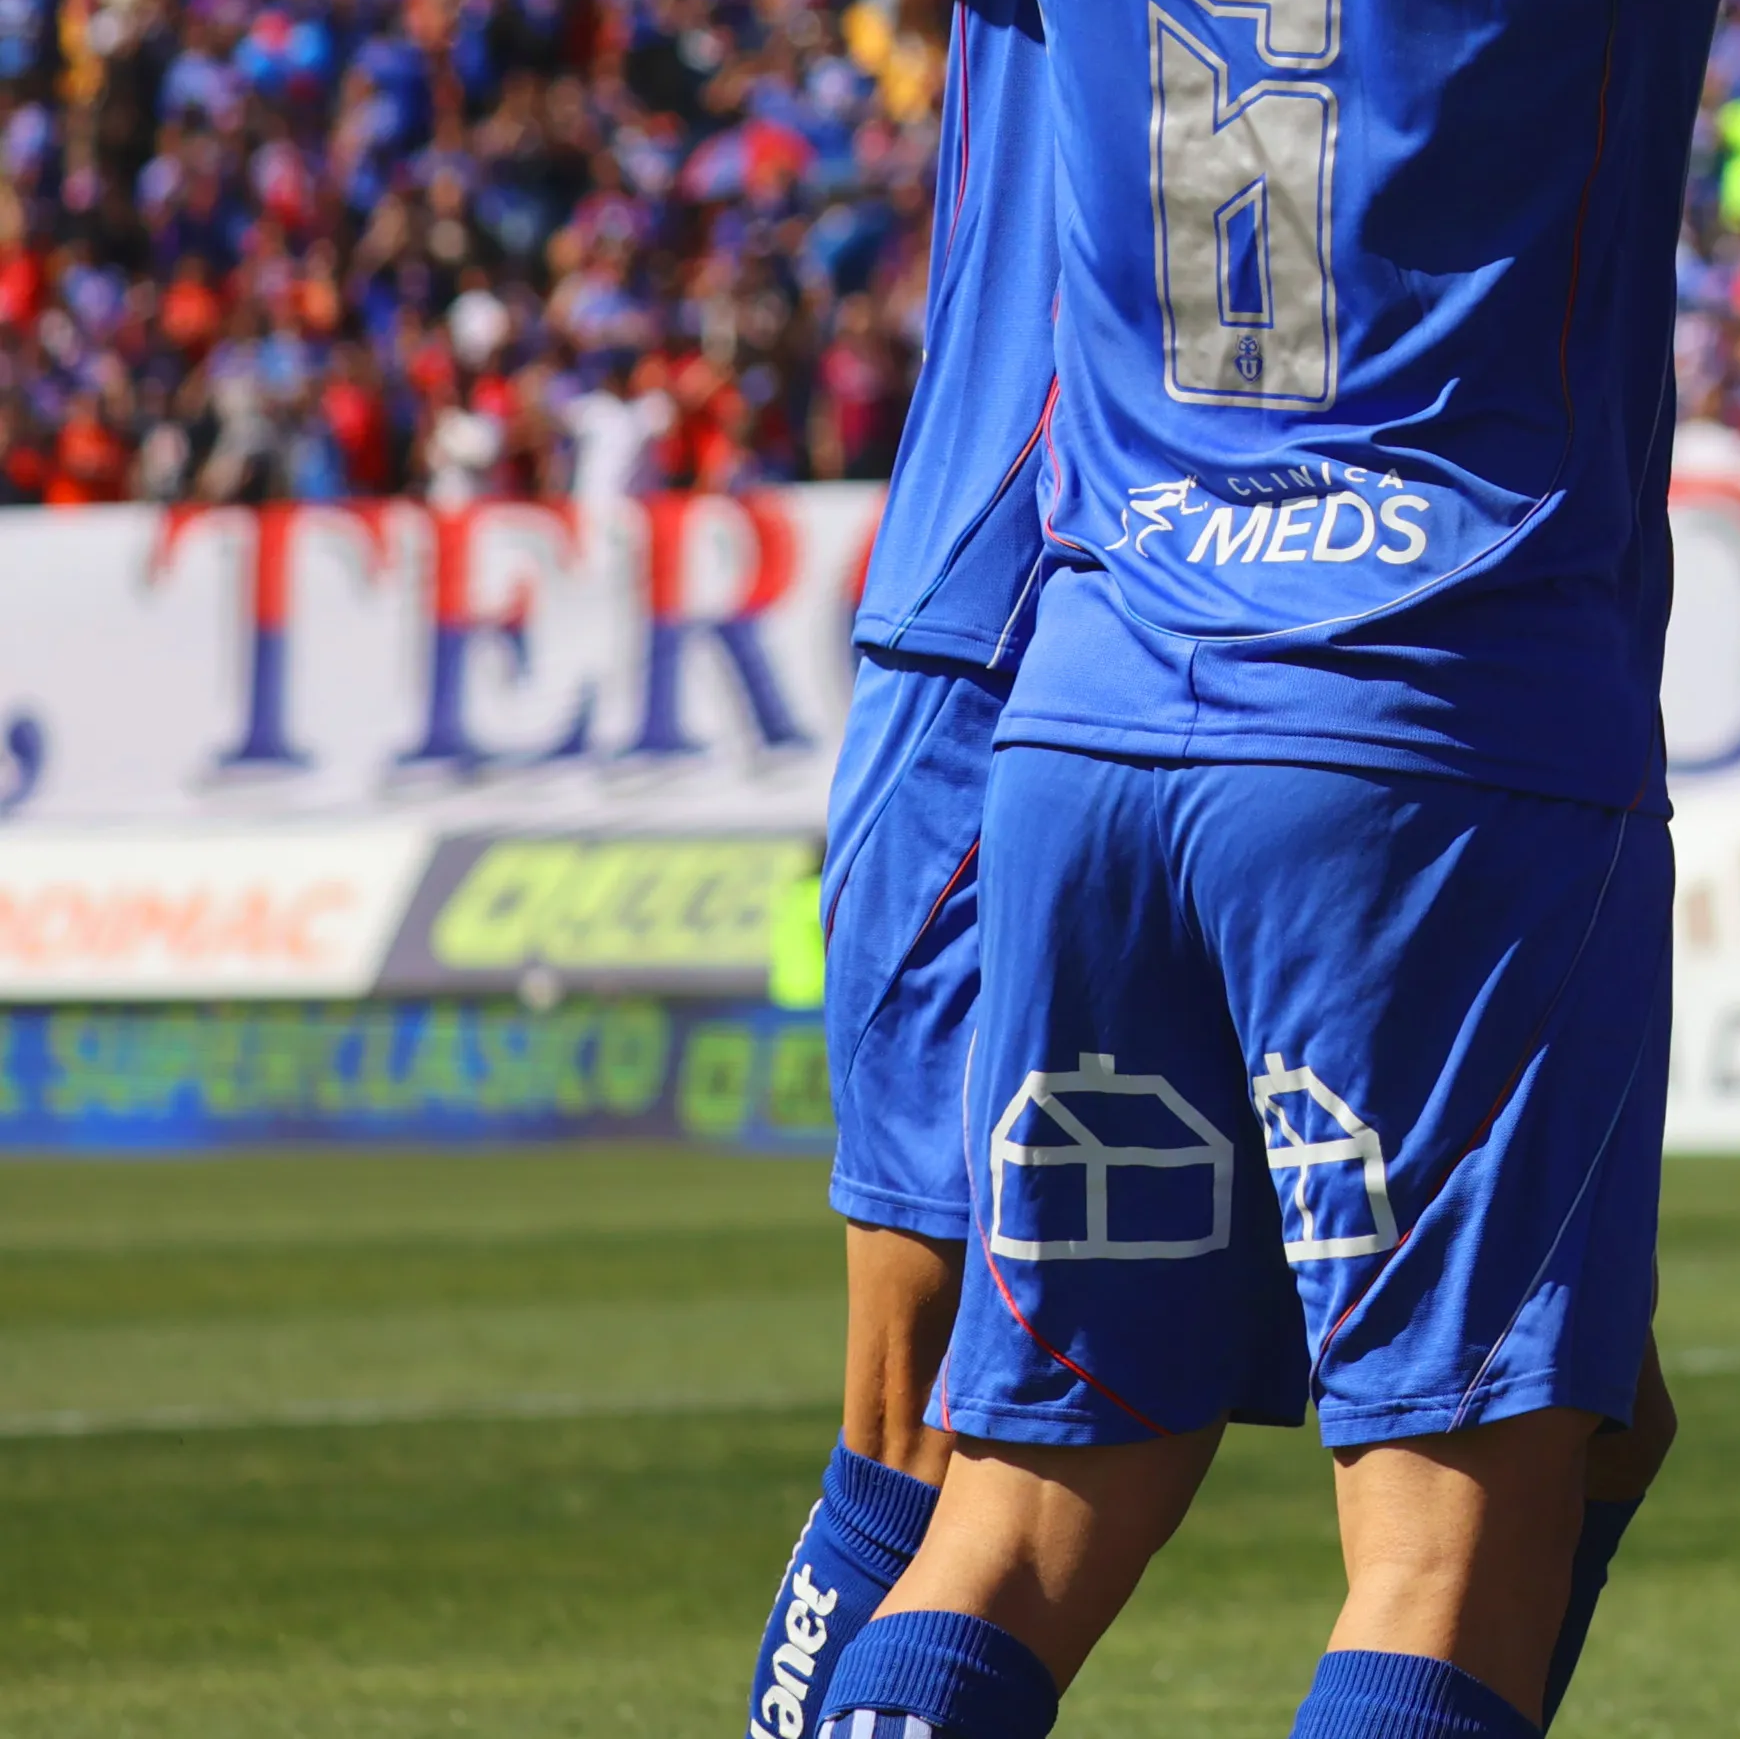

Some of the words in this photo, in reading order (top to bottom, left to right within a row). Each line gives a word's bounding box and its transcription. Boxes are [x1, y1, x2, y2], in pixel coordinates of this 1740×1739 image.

[1227, 461, 1404, 496] CLINICA
[1186, 490, 1430, 565] MEDS
[143, 492, 870, 768] TER
[0, 882, 356, 966] DIMAC
[751, 1563, 838, 1739] anet
